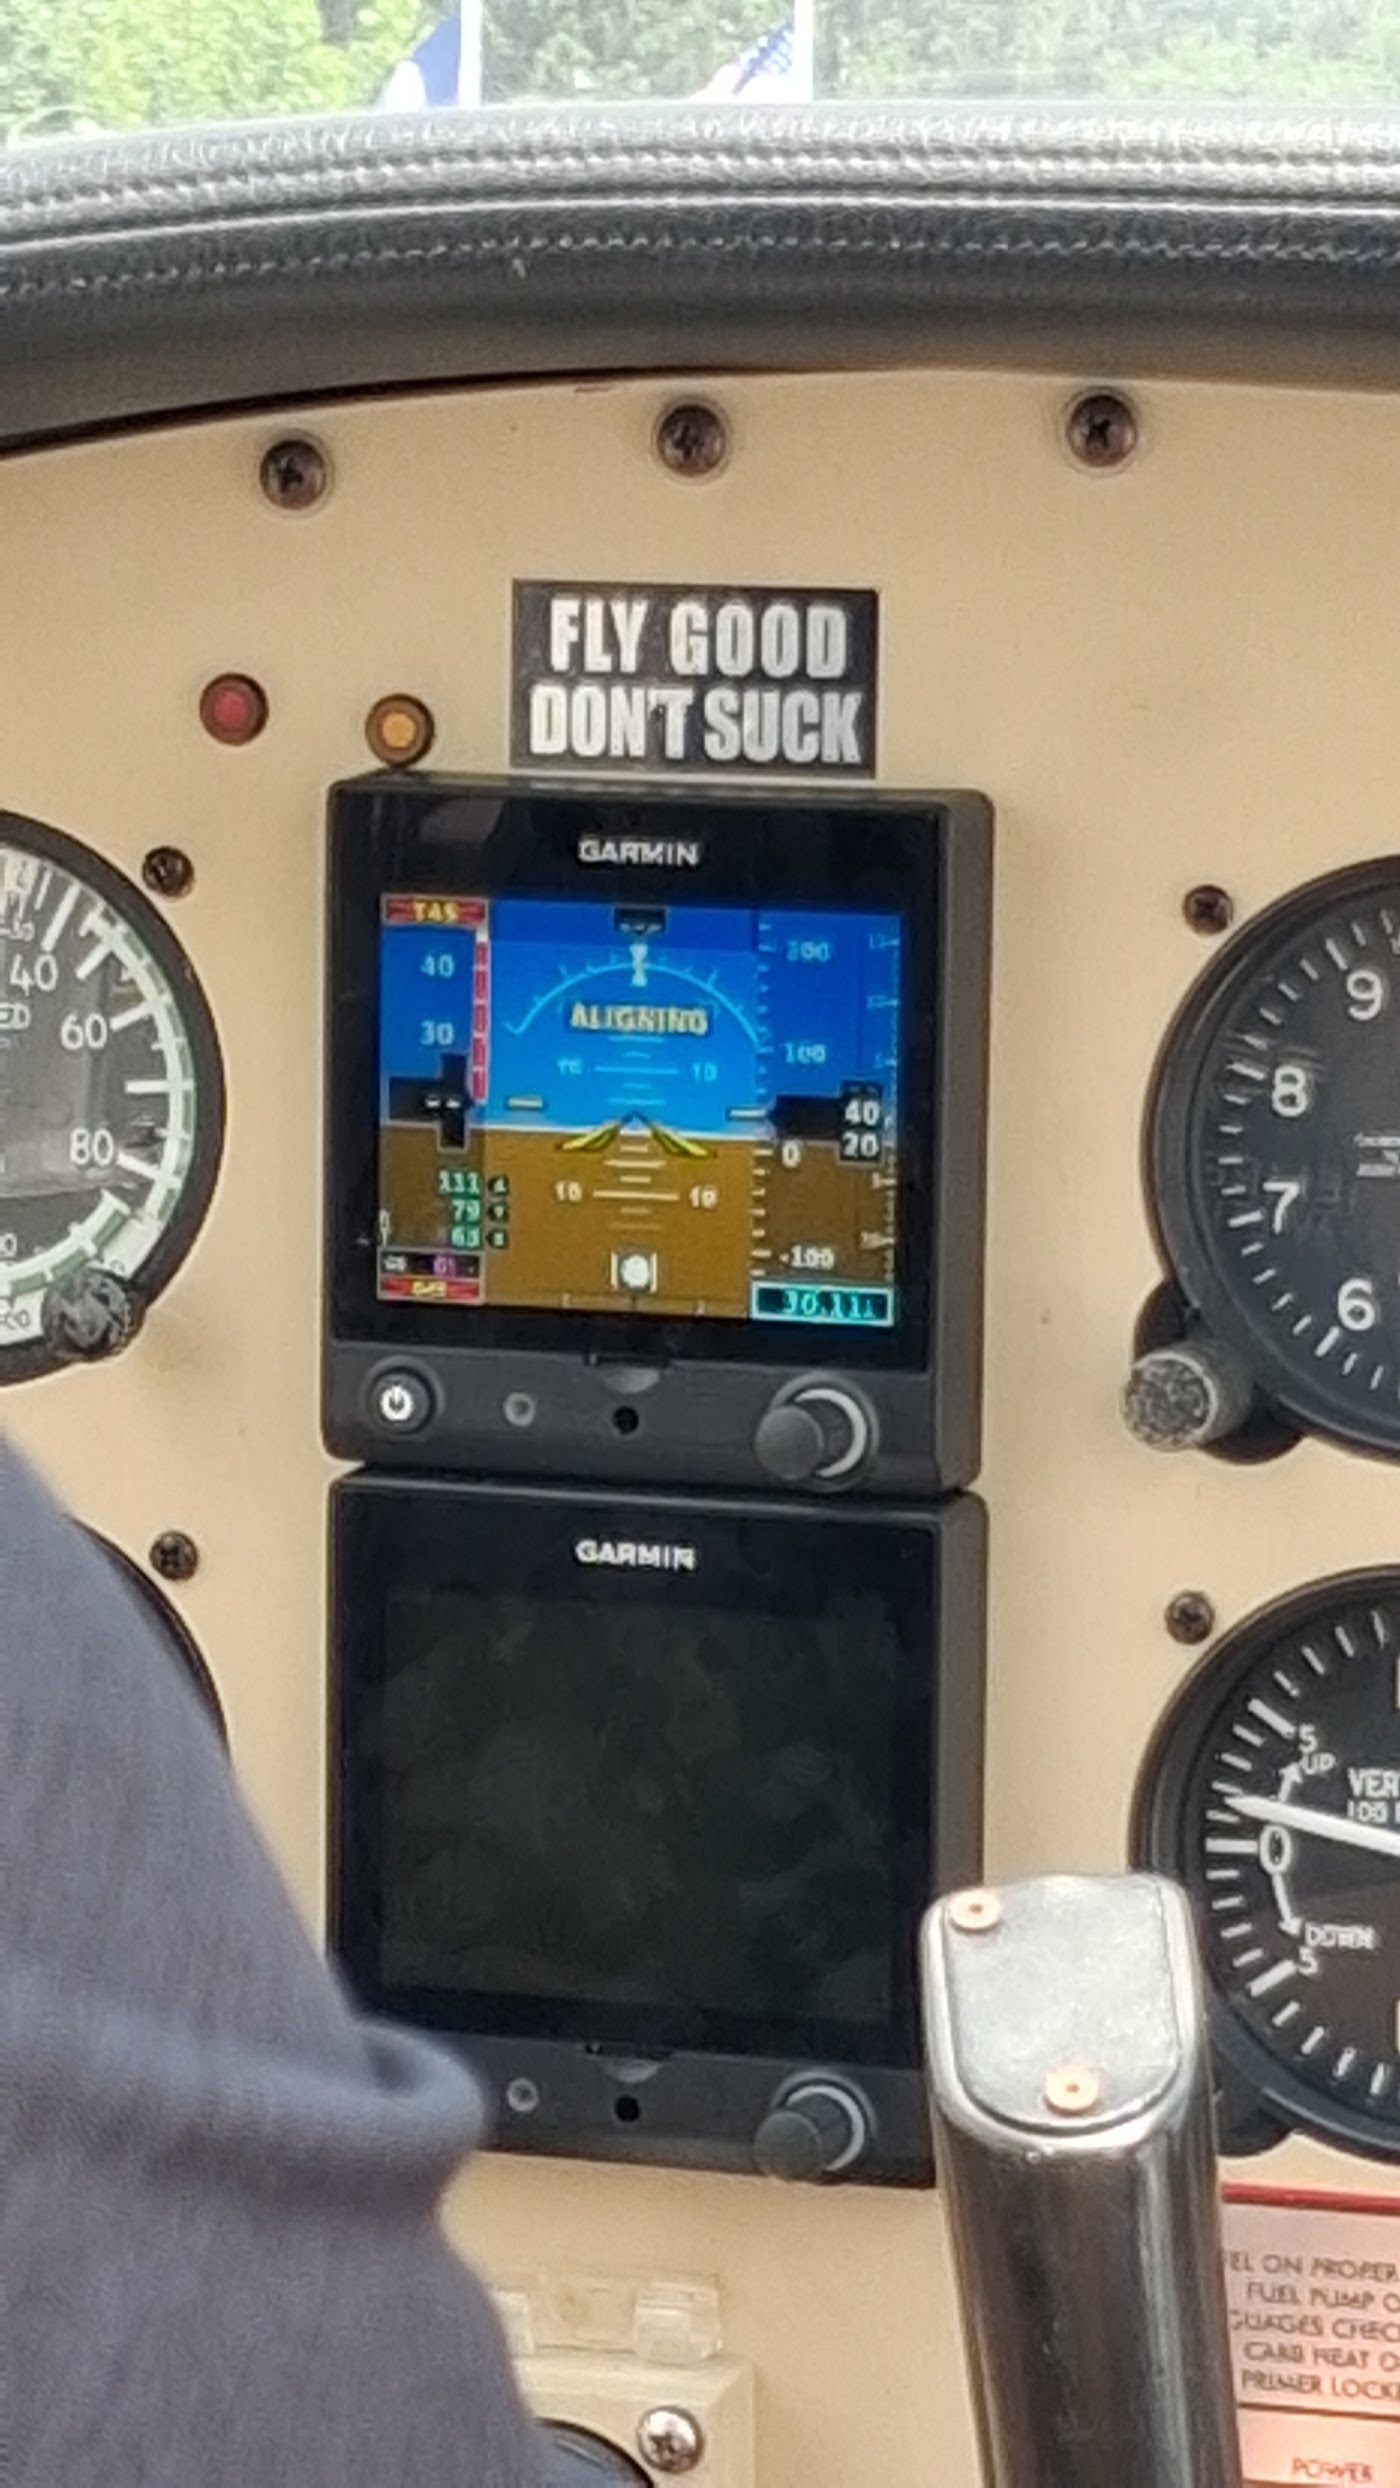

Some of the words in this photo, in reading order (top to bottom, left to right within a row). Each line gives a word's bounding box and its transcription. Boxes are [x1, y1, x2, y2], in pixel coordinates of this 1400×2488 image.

[549, 597, 648, 673] FLY
[669, 602, 847, 678] GOOD
[529, 683, 694, 760] DON'T
[703, 688, 862, 763] SUCK
[578, 839, 700, 866] GARMIN
[10, 953, 58, 997] 40
[420, 954, 456, 978] 40
[1346, 969, 1383, 1021] 9
[60, 1012, 107, 1051] 60
[420, 1021, 455, 1045] 30
[571, 1001, 708, 1036] ALIGNING
[1272, 1064, 1308, 1117] 8
[844, 1100, 881, 1127] 40
[70, 1128, 115, 1166] 80
[782, 1142, 801, 1168] 0
[843, 1132, 879, 1157] 20
[1263, 1181, 1301, 1234] 7
[1337, 1277, 1376, 1331] 6
[575, 1539, 696, 1571] GARMIN
[1301, 1752, 1336, 1775] UP
[1259, 1826, 1292, 1874] 0
[1305, 1923, 1377, 1949] DOWN
[1299, 1947, 1319, 1975] 5
[1229, 2252, 1254, 2272] EL
[1248, 2282, 1300, 2305] FUEL
[1332, 2376, 1400, 2400] LOCK
